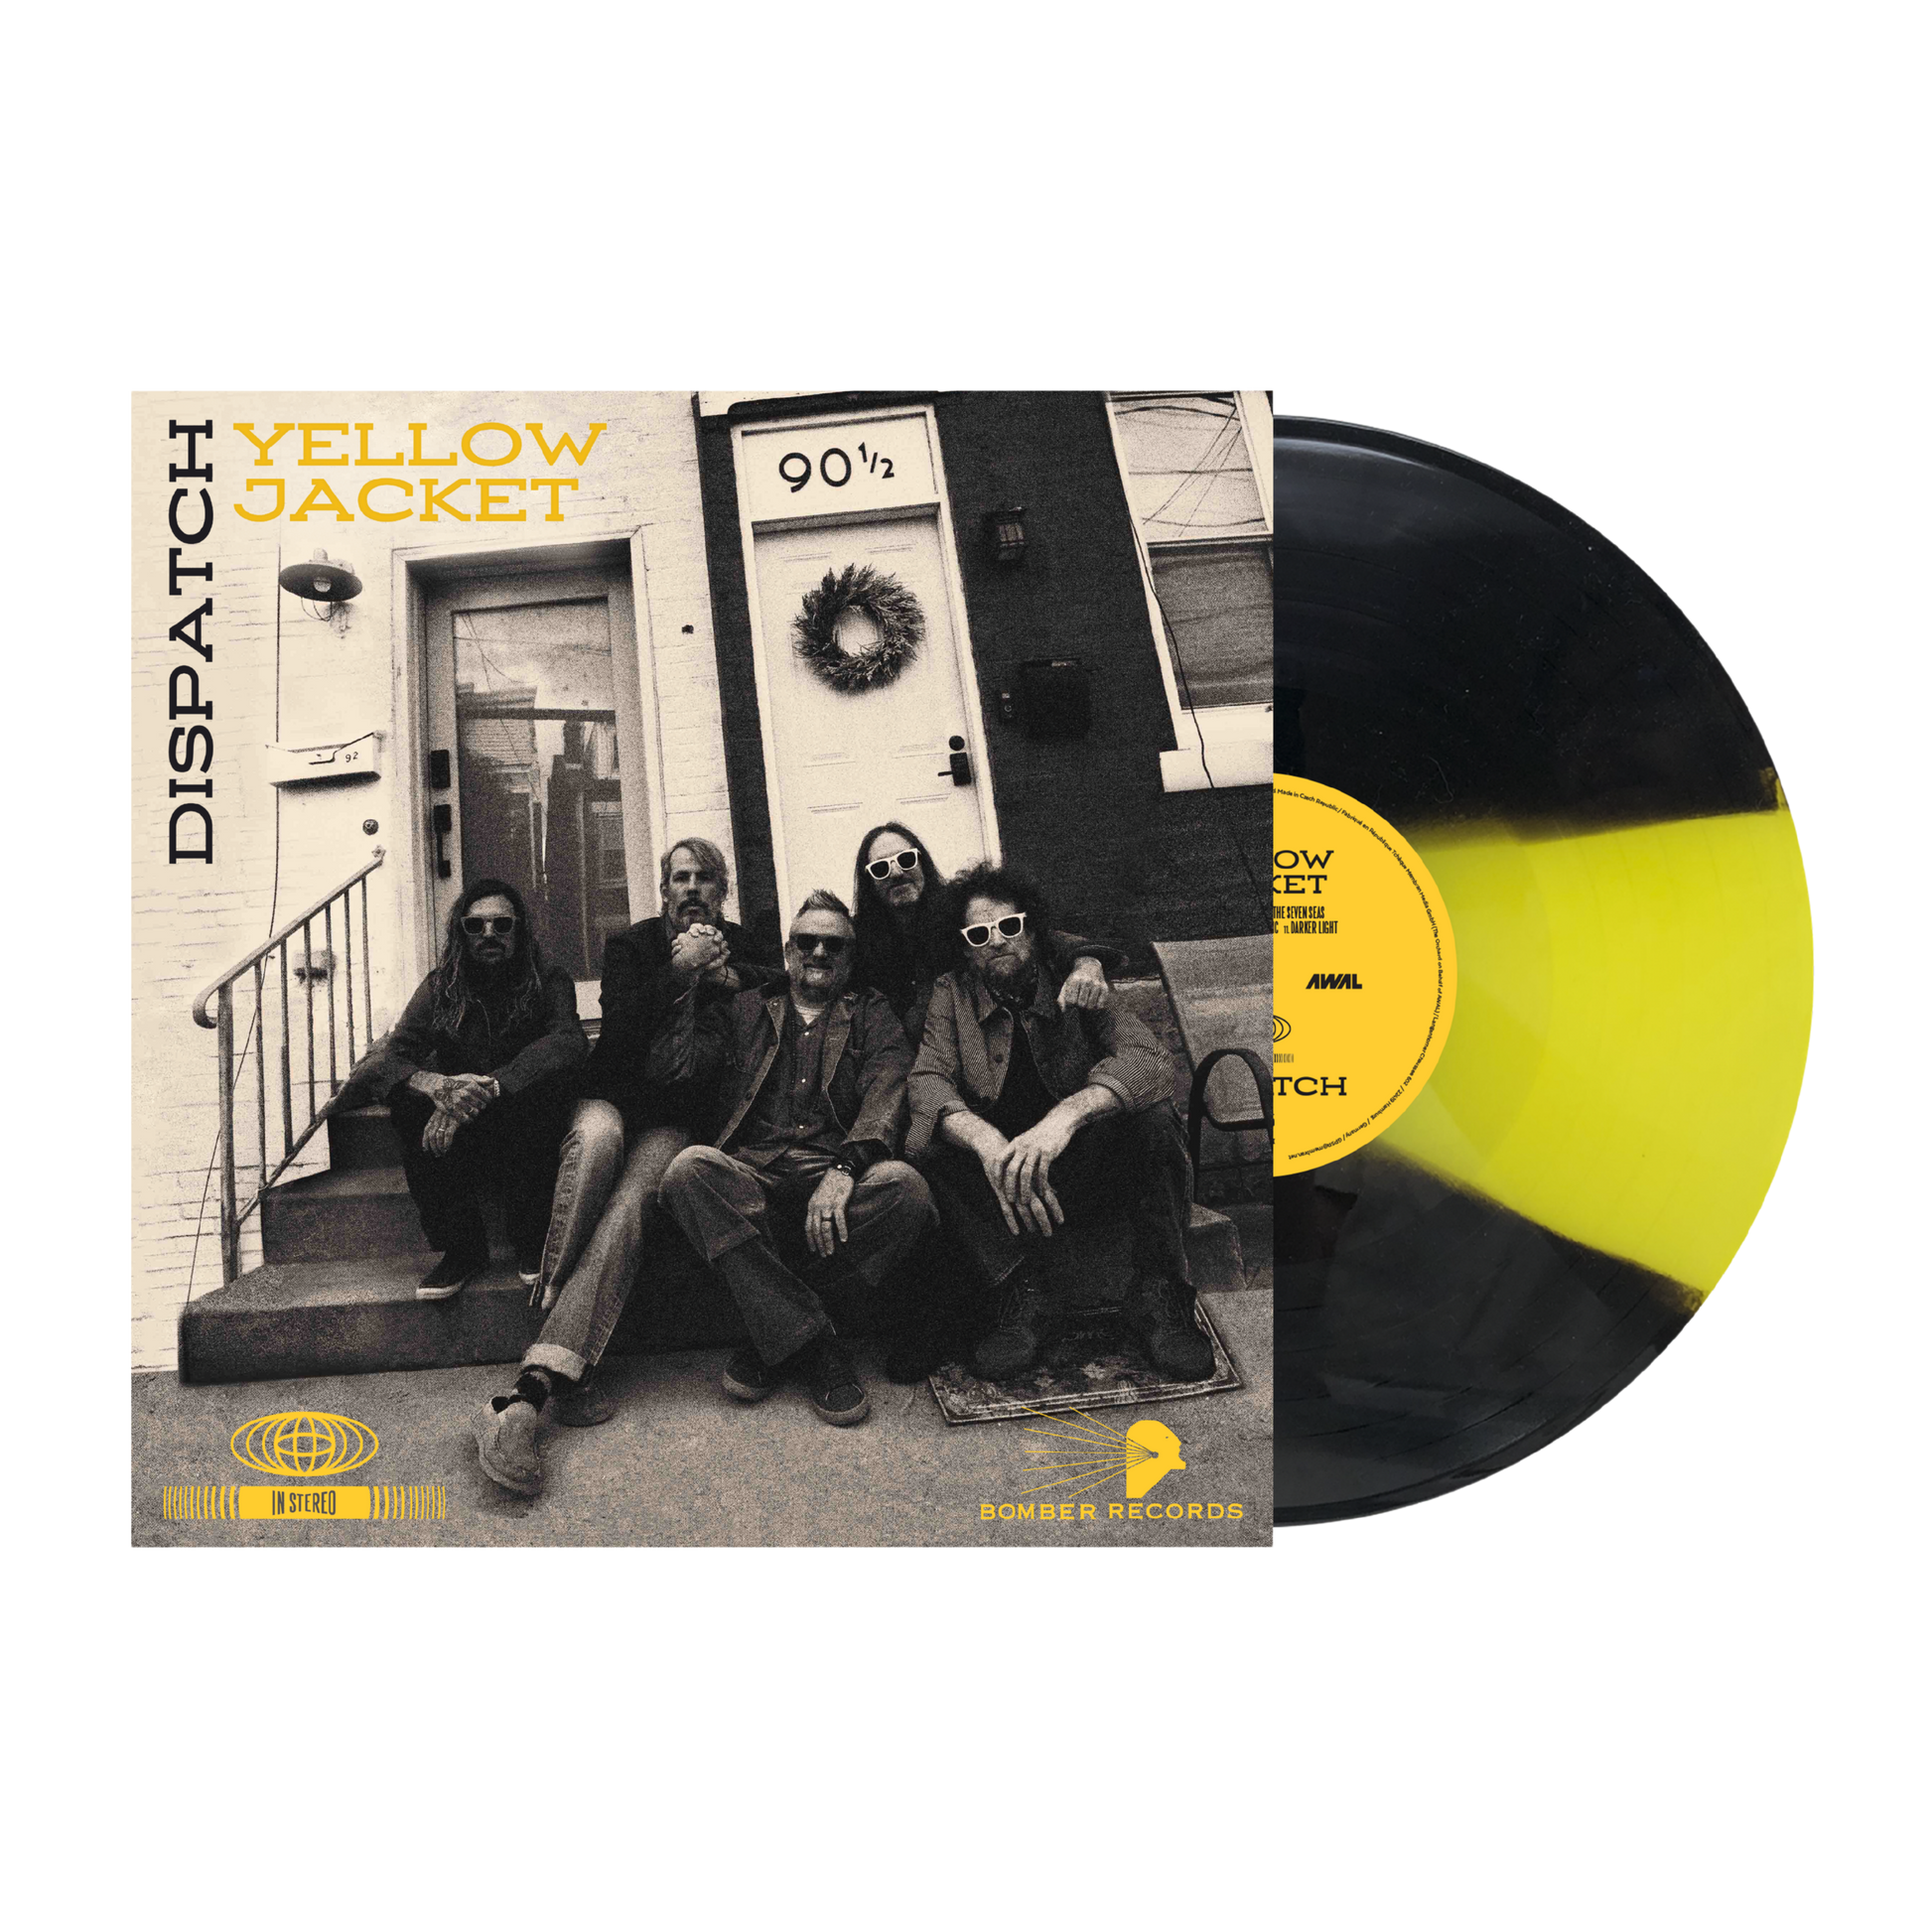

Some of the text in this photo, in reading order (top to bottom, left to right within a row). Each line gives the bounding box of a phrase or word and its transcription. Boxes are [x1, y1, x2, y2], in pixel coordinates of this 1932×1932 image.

[233, 423, 607, 467] YELLOW
[234, 479, 578, 522] JACKET
[169, 420, 212, 864] DISPATCH
[345, 752, 358, 763] 92
[1300, 793, 1314, 802] Czech
[1315, 798, 1338, 812] Republic
[1406, 869, 1422, 893] Membran
[1419, 892, 1429, 908] Media
[1286, 905, 1307, 918] SEVEN
[1308, 905, 1324, 918] SEAS
[1426, 908, 1437, 926] GmbH
[1291, 920, 1316, 933] DARKER
[1318, 920, 1338, 933] LIGHT
[1306, 974, 1362, 989] AWAL
[1370, 1101, 1391, 1120] Hamburg
[1345, 1122, 1367, 1138] Germany
[272, 1490, 336, 1516] IN STEREO
[980, 1503, 1243, 1520] BOMBER RECORDS
